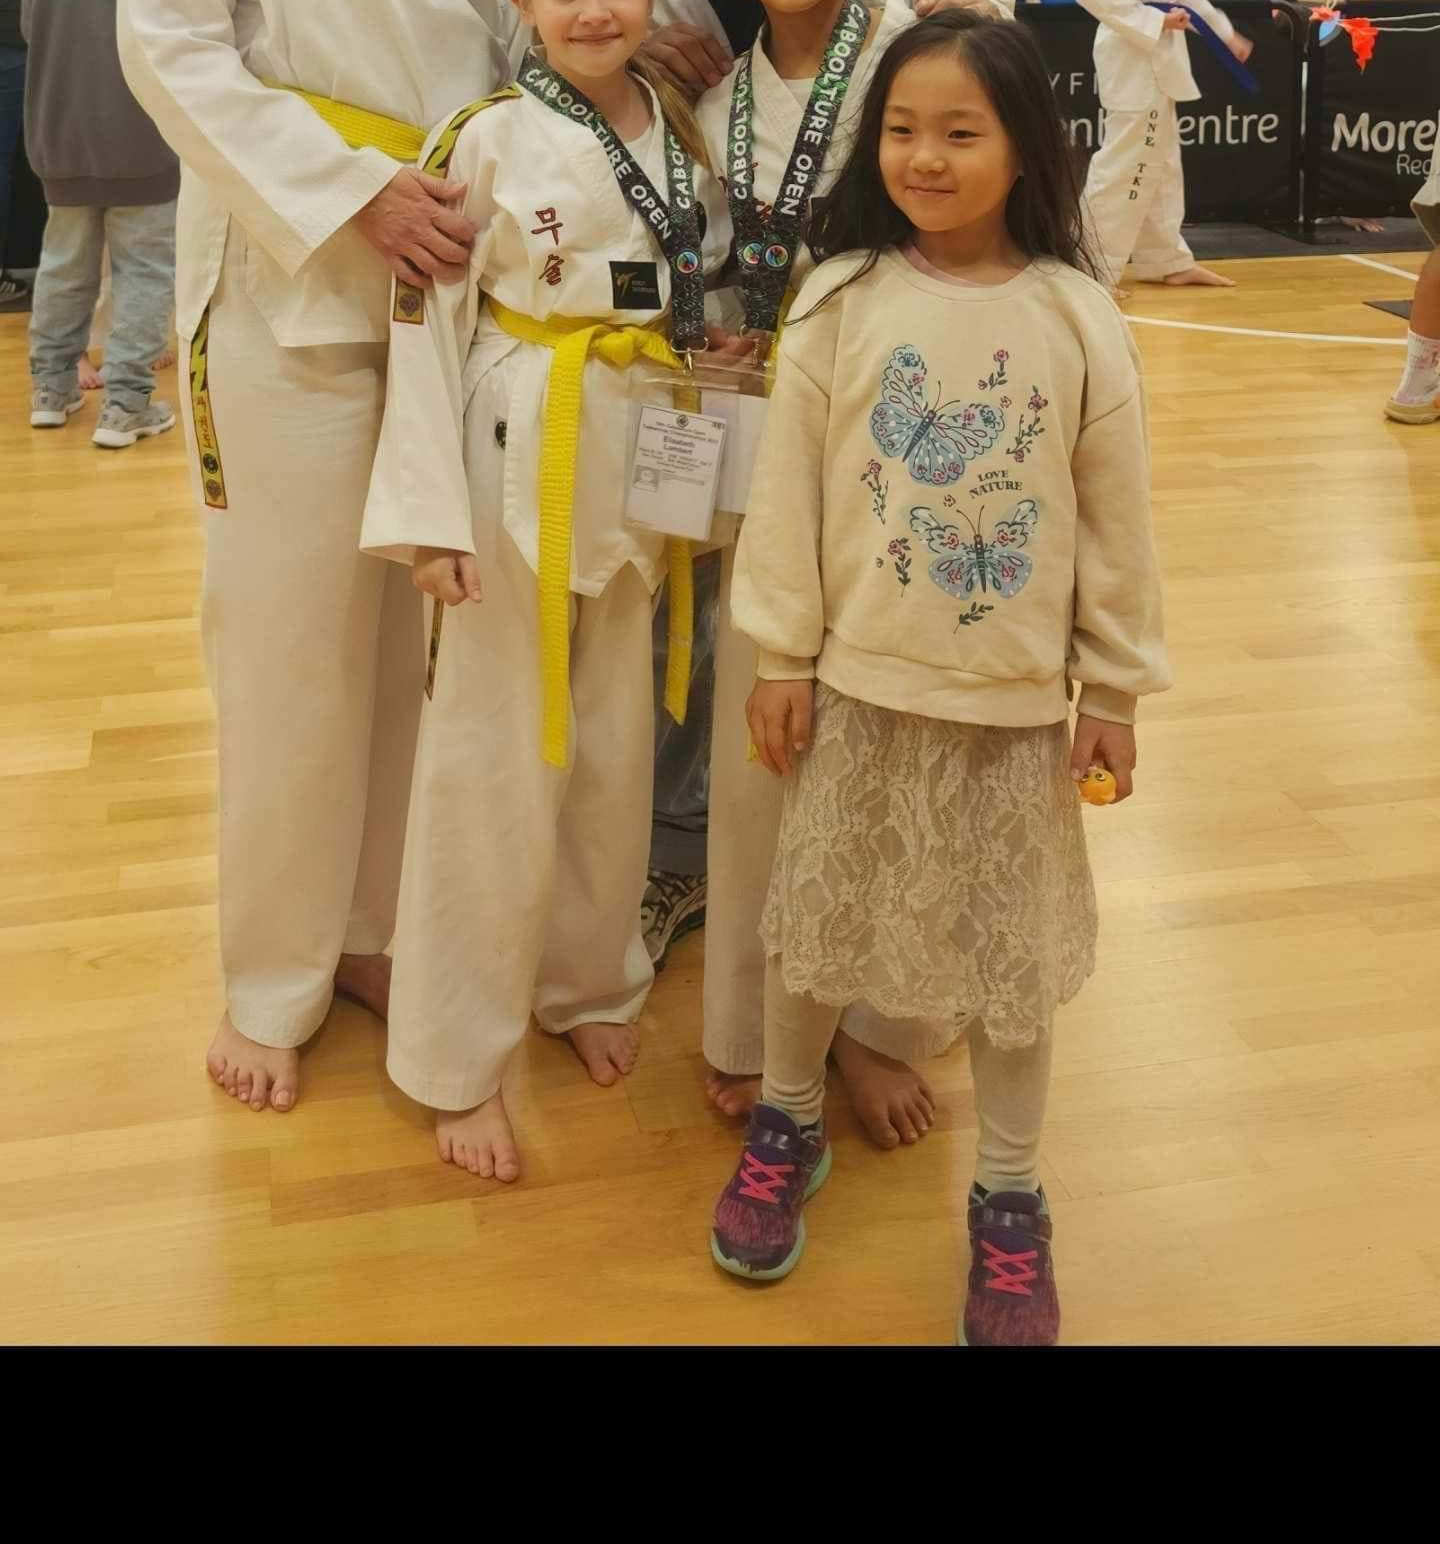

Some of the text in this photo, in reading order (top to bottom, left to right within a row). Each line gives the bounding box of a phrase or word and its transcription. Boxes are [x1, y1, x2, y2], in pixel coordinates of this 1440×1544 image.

[780, 4, 864, 216] CABOOLTURE OPEN
[1331, 112, 1440, 153] More
[525, 68, 672, 240] CABOOLTURE OPEN
[1128, 109, 1158, 200] ONE TKD
[969, 480, 1023, 500] NATURE
[977, 469, 1009, 482] LOVE
